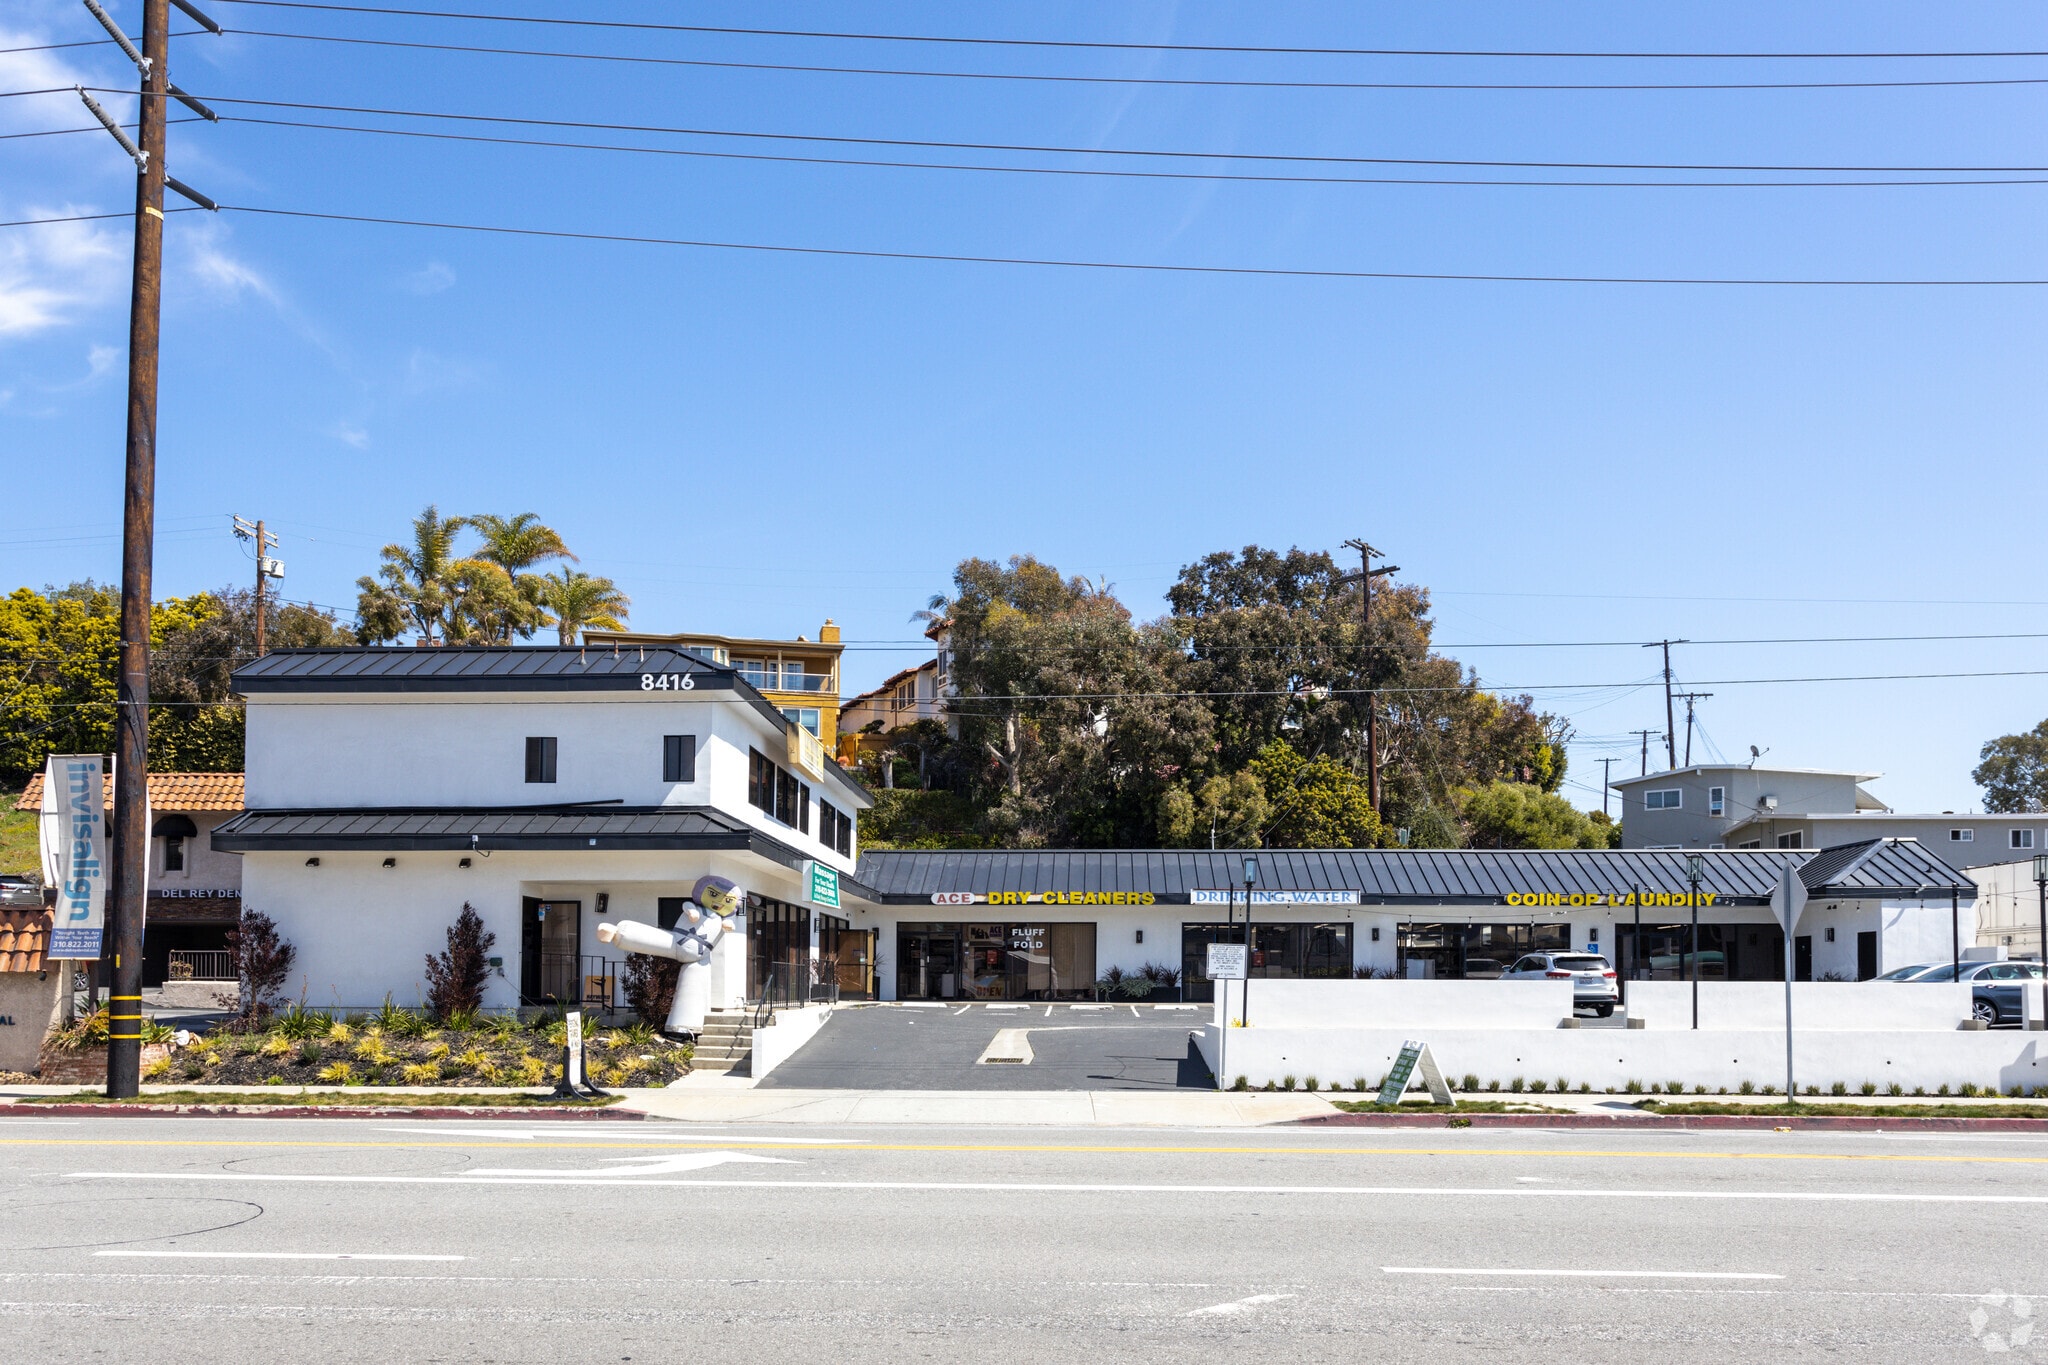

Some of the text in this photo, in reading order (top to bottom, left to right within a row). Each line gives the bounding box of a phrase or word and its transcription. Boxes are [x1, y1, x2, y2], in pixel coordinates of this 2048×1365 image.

[641, 673, 695, 690] 8416
[65, 763, 100, 921] invisalign
[162, 889, 185, 898] DEL
[190, 889, 213, 898] REY
[937, 891, 1155, 905] ACE DRY CLEANERS
[1196, 891, 1351, 902] DRINKING WATER
[1507, 892, 1716, 907] COIN-OP LAUNDRY
[1011, 928, 1045, 936] FLUFF
[1013, 941, 1043, 949] FOLD
